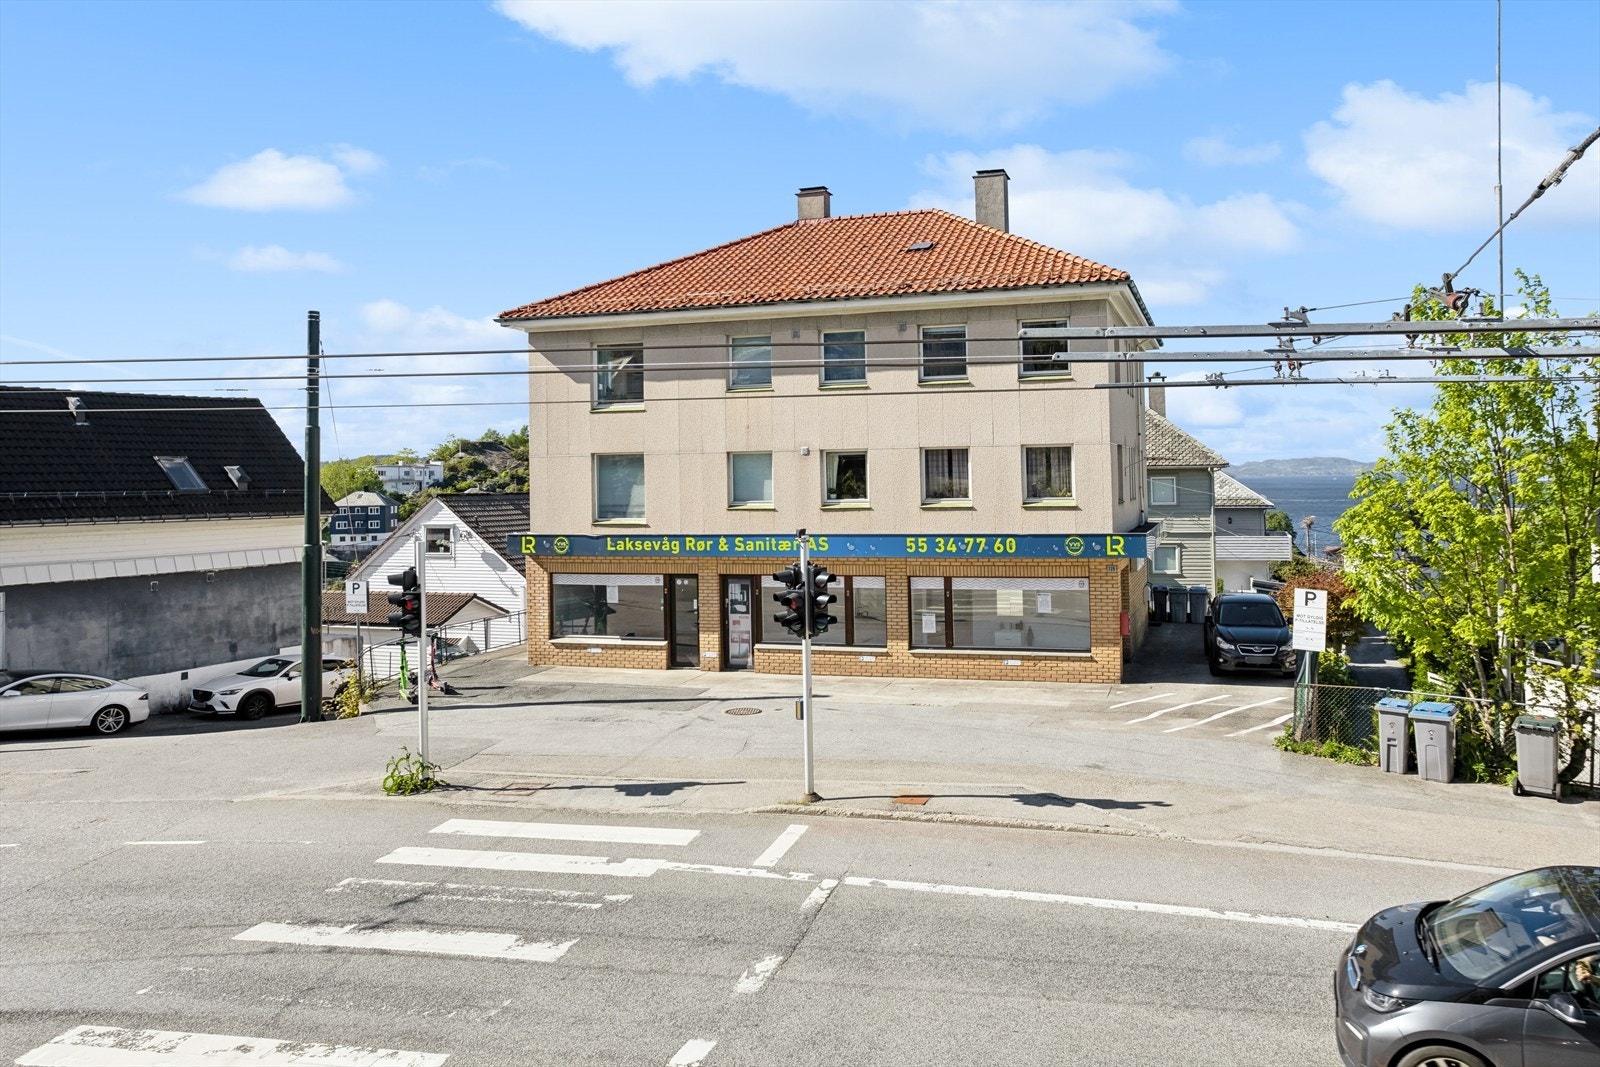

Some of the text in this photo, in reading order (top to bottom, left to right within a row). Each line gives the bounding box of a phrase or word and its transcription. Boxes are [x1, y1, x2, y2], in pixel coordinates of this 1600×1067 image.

[606, 536, 829, 554] Laksevåg Rør & Sanitær AS
[906, 537, 1016, 553] 55 34 77 60
[352, 582, 361, 594] P
[1304, 590, 1317, 606] P
